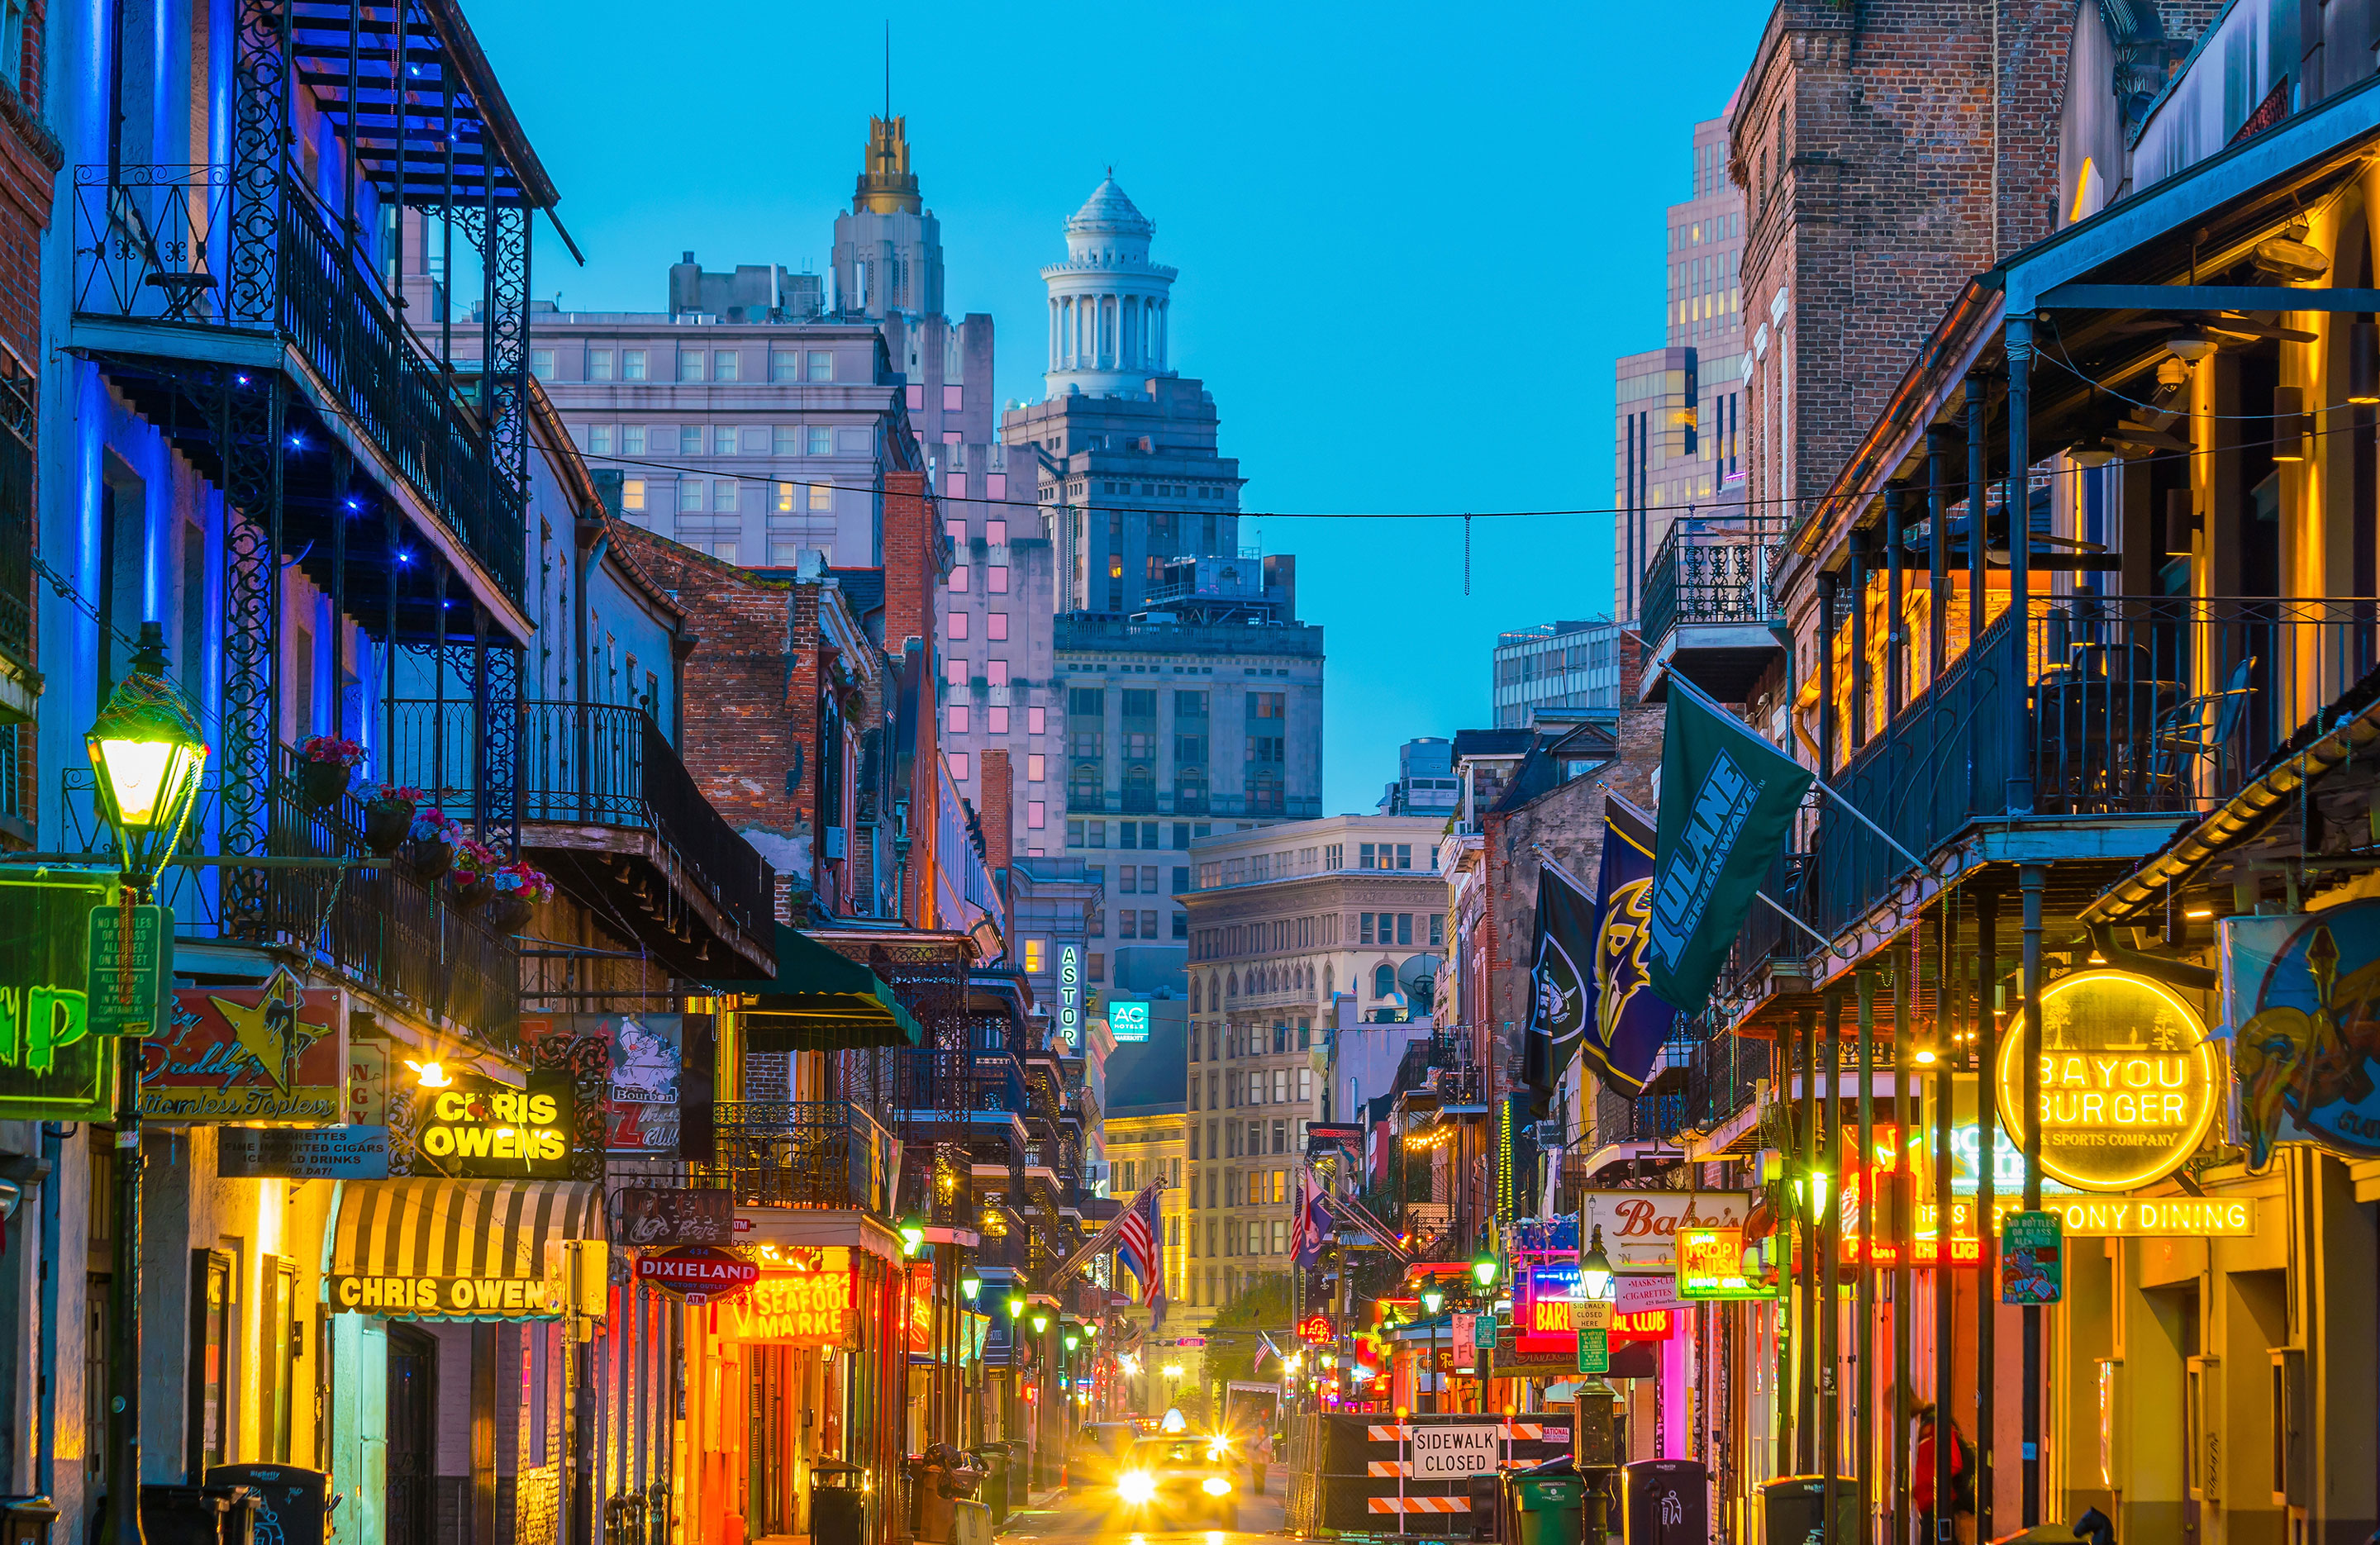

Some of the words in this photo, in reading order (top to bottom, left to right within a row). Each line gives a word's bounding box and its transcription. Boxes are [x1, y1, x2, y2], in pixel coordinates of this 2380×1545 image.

[1651, 755, 1745, 968] TULANE
[1683, 852, 1724, 934] GREEN
[1718, 786, 1757, 851] WAVE
[98, 917, 110, 929] NO
[113, 917, 152, 929] BTLES
[102, 929, 113, 940] OR
[103, 942, 145, 953] ALLED
[98, 954, 111, 965] ON
[1062, 946, 1077, 1046] ASTOR
[1115, 1006, 1144, 1023] AC
[2040, 1056, 2190, 1089] BAYOU
[616, 1089, 674, 1102] Bourbon
[142, 1094, 242, 1115] ttomless
[245, 1091, 336, 1118] Topless
[435, 1091, 558, 1124] CHRIS
[2040, 1091, 2188, 1126] BURGER
[225, 1143, 255, 1152] FINE
[260, 1143, 330, 1153] IMORTED
[334, 1143, 384, 1153] CIGARS
[424, 1126, 566, 1161] OWENS
[2052, 1134, 2106, 1146] SPORTS
[2108, 1133, 2178, 1147] COMPANY
[243, 1154, 265, 1163] ICE
[309, 1155, 361, 1164] DRINKS
[306, 1167, 332, 1176] DAT!
[2008, 1219, 2019, 1227] NO
[2021, 1219, 2056, 1228] BOTTLES
[2140, 1205, 2246, 1229] DINING
[2012, 1228, 2023, 1236] OR
[2025, 1228, 2052, 1236] GLASS
[1685, 1242, 1739, 1258] TROPI
[642, 1261, 756, 1280] DIXIELAND
[1711, 1257, 1741, 1274] ISL
[809, 1273, 850, 1291] 424
[1630, 1278, 1657, 1288] MASKS
[339, 1277, 438, 1308] CHRIS
[450, 1278, 545, 1309] OWEN
[687, 1295, 706, 1305] ATM
[1625, 1288, 1673, 1300] CIGARETTES
[759, 1310, 843, 1338] MARKE
[1416, 1433, 1494, 1450] SIDEWALK
[1426, 1454, 1486, 1471] CLOSED
